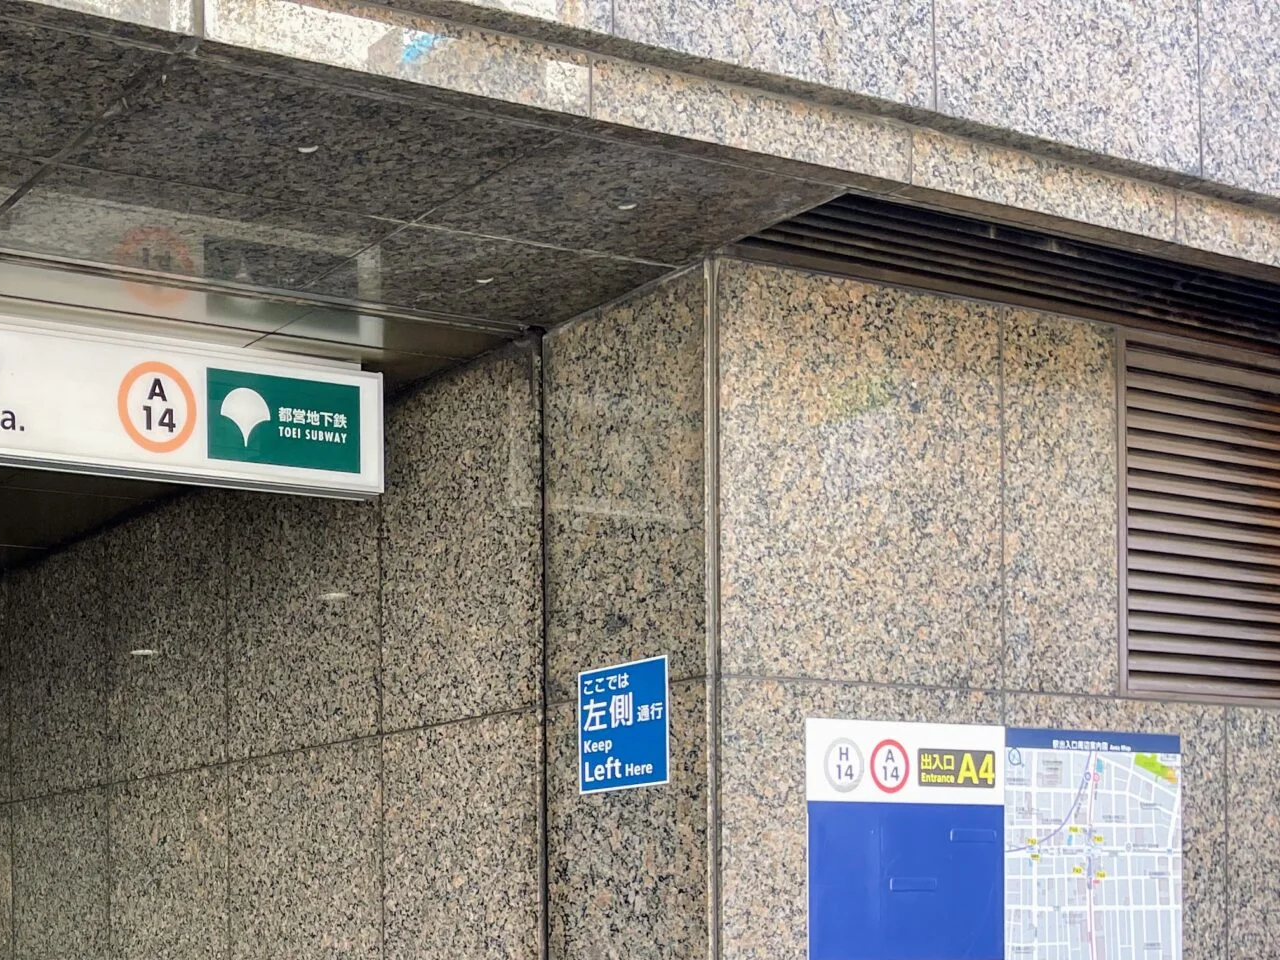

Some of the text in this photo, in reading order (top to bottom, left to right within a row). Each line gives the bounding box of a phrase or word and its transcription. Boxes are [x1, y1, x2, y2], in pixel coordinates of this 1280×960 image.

[147, 378, 168, 402] A
[142, 404, 177, 434] 14
[278, 406, 348, 430] 都営地下鉄
[278, 425, 347, 445] TOEI SUBWAY
[583, 672, 629, 696] ここでは
[582, 692, 663, 732] 左側 通行
[583, 740, 613, 754] Keep
[838, 746, 849, 762] H
[885, 749, 896, 764] A
[584, 757, 653, 783] Left Here
[836, 764, 855, 781] 14
[920, 754, 955, 771] 出入口
[956, 753, 996, 785] A4
[882, 766, 900, 782] 14
[920, 773, 955, 784] Entrance
